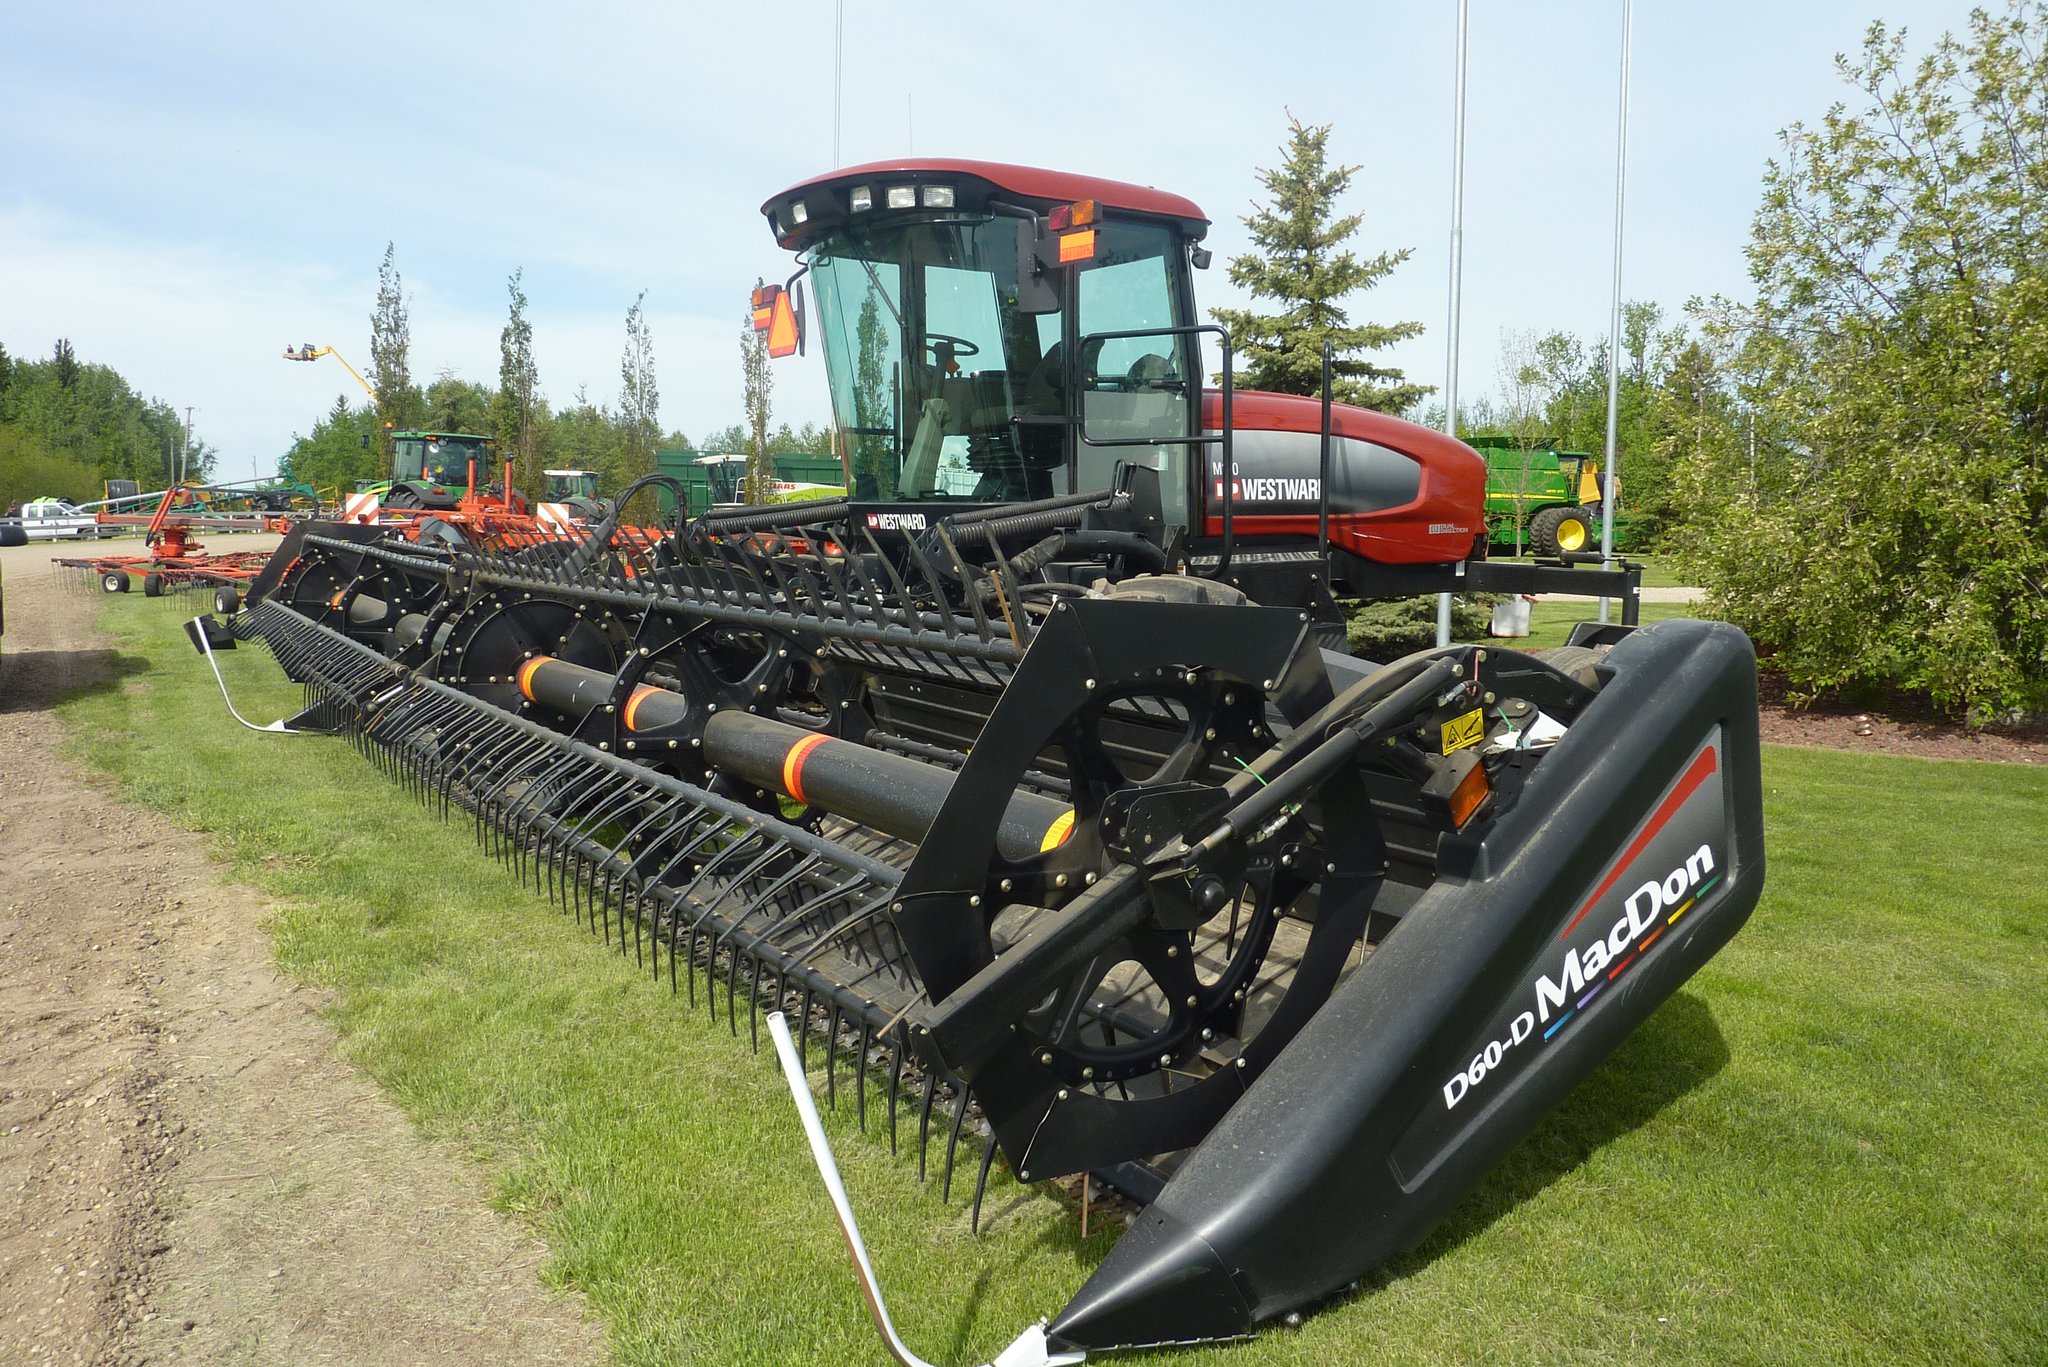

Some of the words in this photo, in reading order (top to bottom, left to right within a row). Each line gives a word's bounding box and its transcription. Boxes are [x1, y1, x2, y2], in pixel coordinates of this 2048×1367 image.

[1241, 478, 1321, 500] WESTWAR
[877, 513, 927, 530] WESTWARD
[1534, 844, 1715, 1024] MacDon
[1442, 1010, 1535, 1110] D60-D
